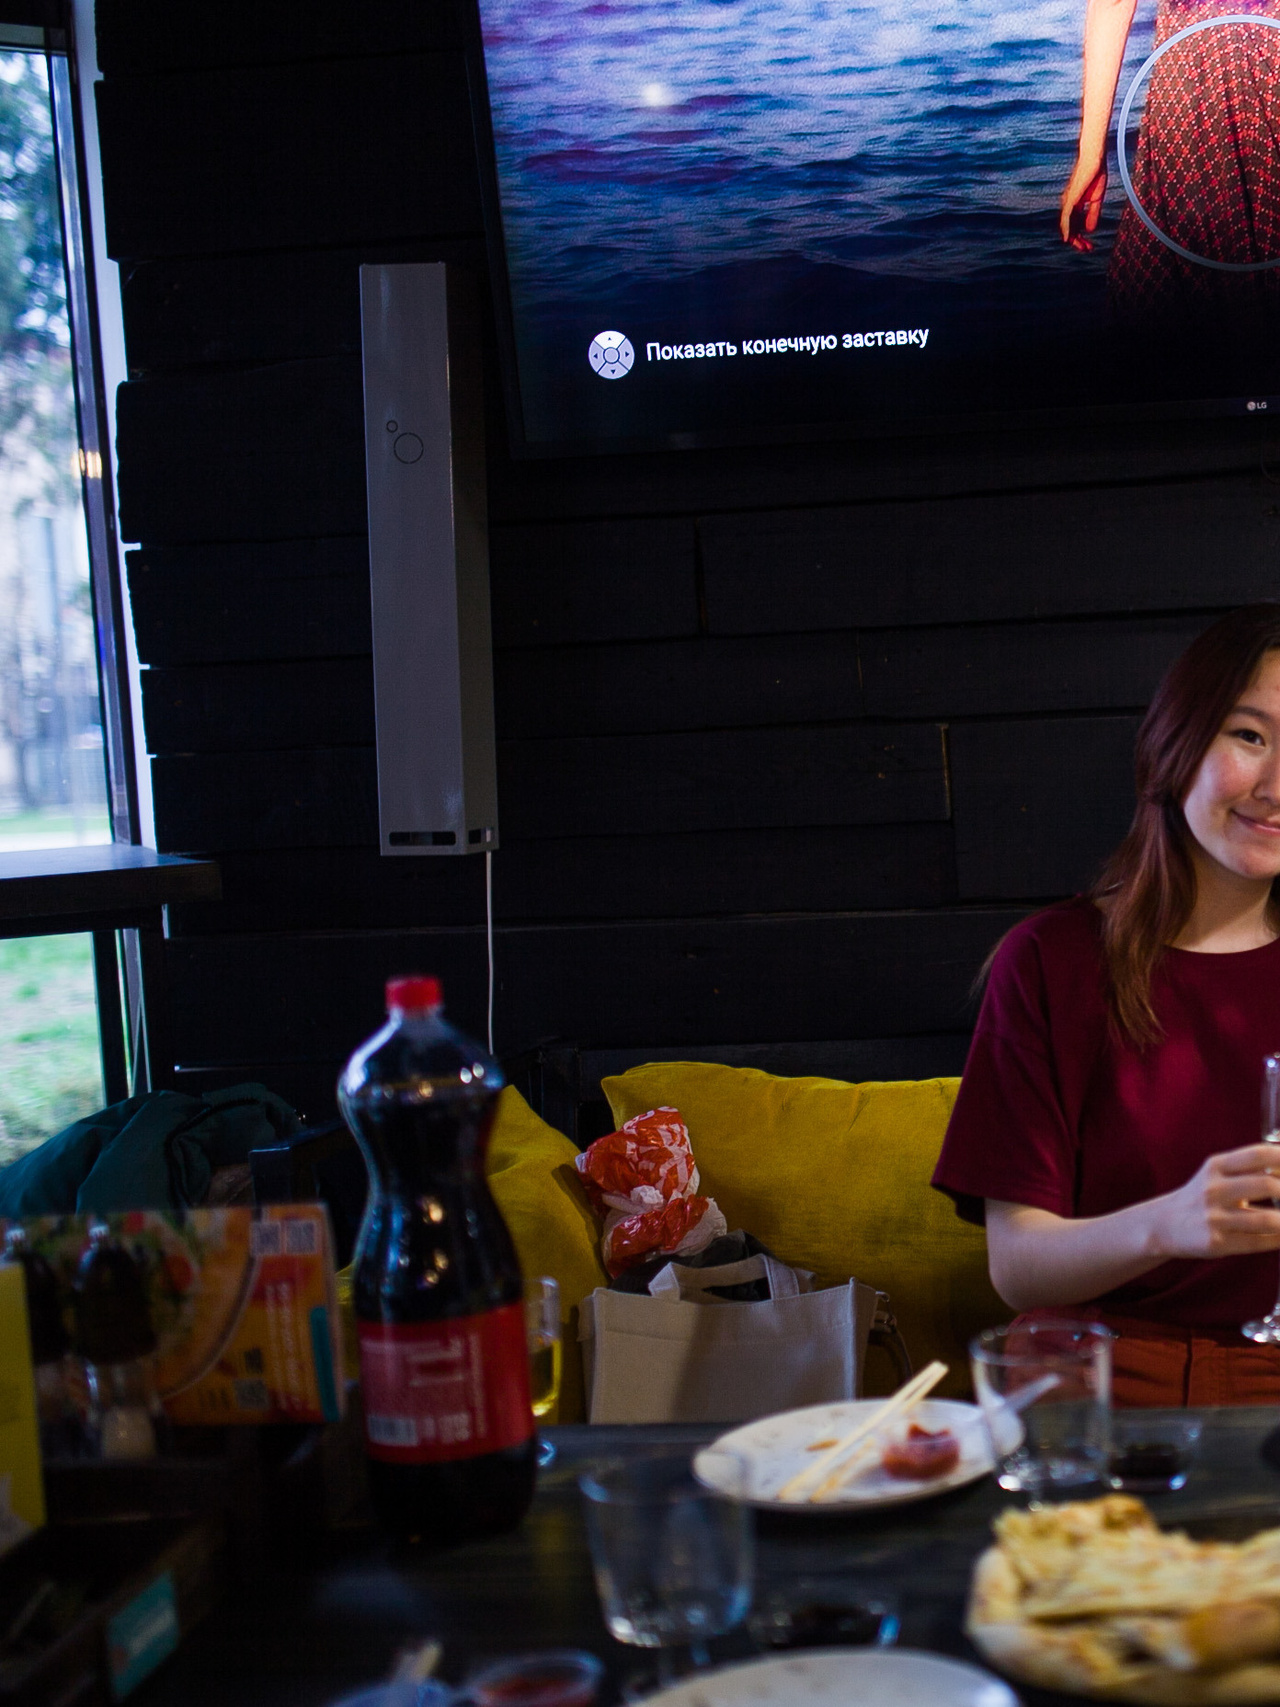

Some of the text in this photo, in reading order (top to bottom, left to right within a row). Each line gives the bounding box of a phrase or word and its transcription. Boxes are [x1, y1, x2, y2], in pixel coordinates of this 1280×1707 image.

[645, 328, 930, 362] Показать конечную заставку
